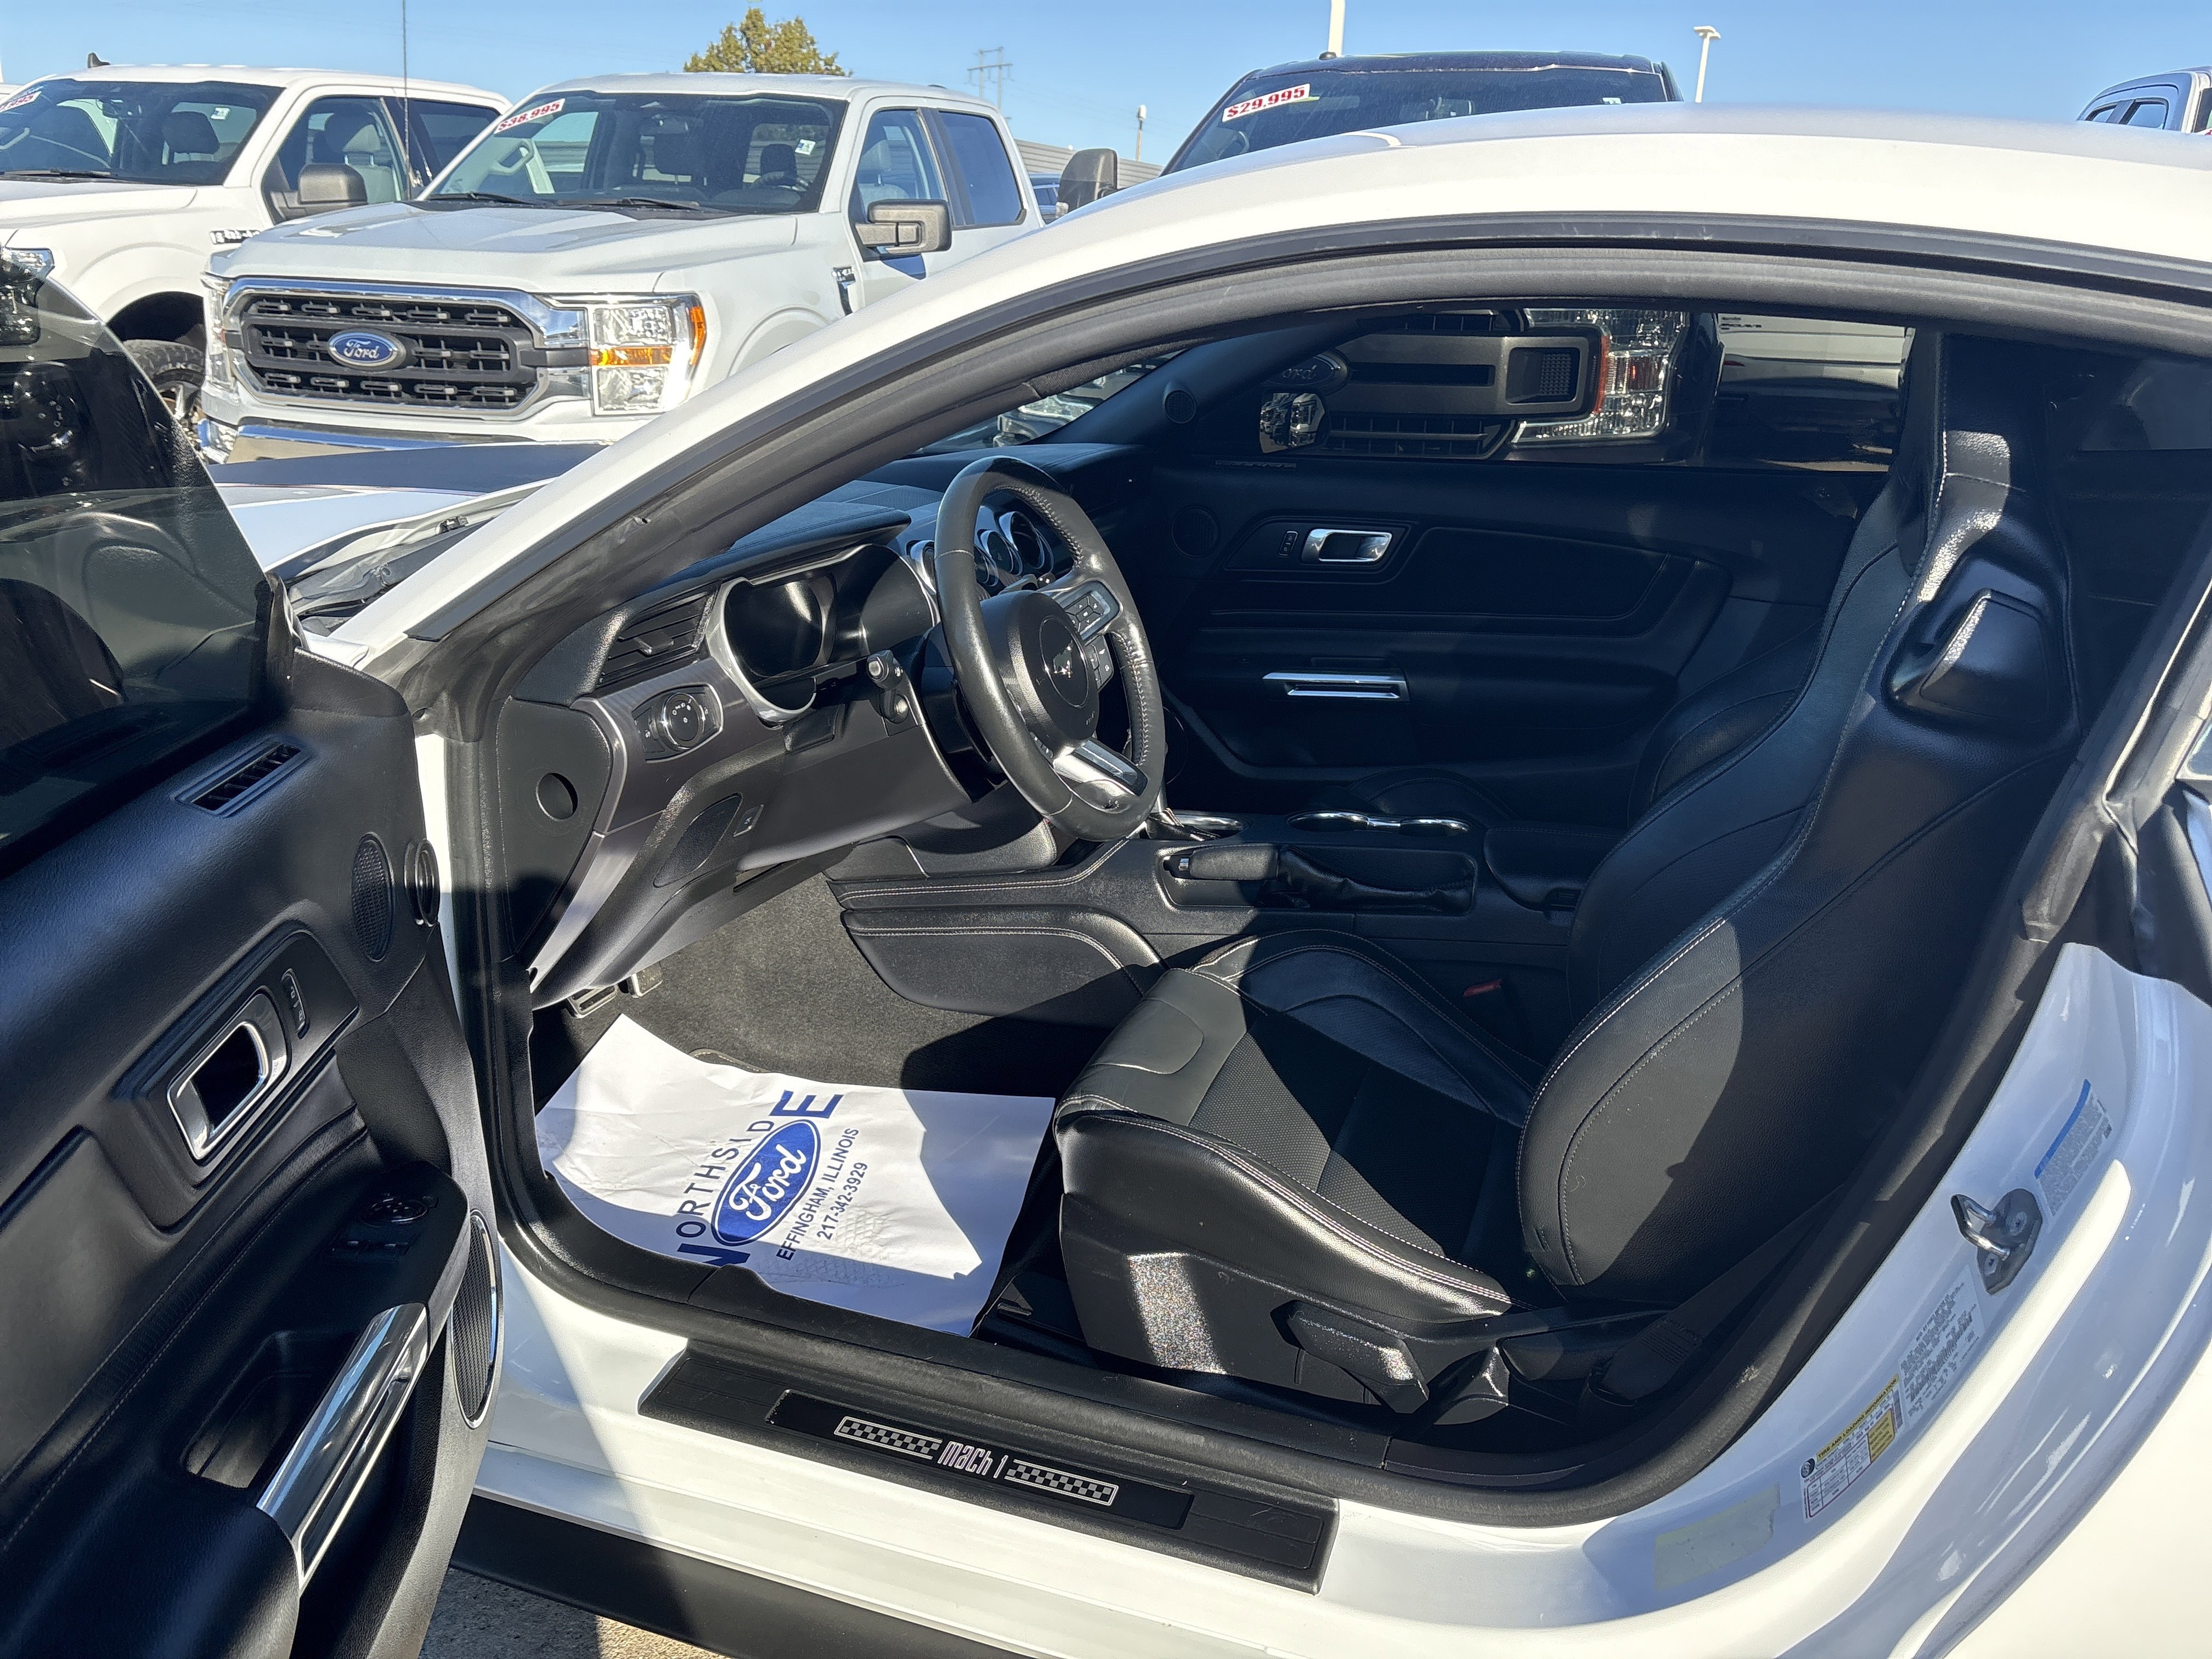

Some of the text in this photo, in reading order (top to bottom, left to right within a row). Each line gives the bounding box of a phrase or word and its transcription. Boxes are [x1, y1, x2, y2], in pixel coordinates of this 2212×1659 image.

[498, 101, 561, 131] $38.995
[1226, 86, 1305, 117] $29.995
[343, 338, 380, 359] Ford
[729, 1143, 807, 1221] Ford
[776, 1127, 860, 1261] EFFINGHAM, ILLINOIS
[816, 1161, 868, 1240] 217-342-3929
[1831, 1436, 1842, 1448] AND
[993, 1454, 1009, 1479] 1
